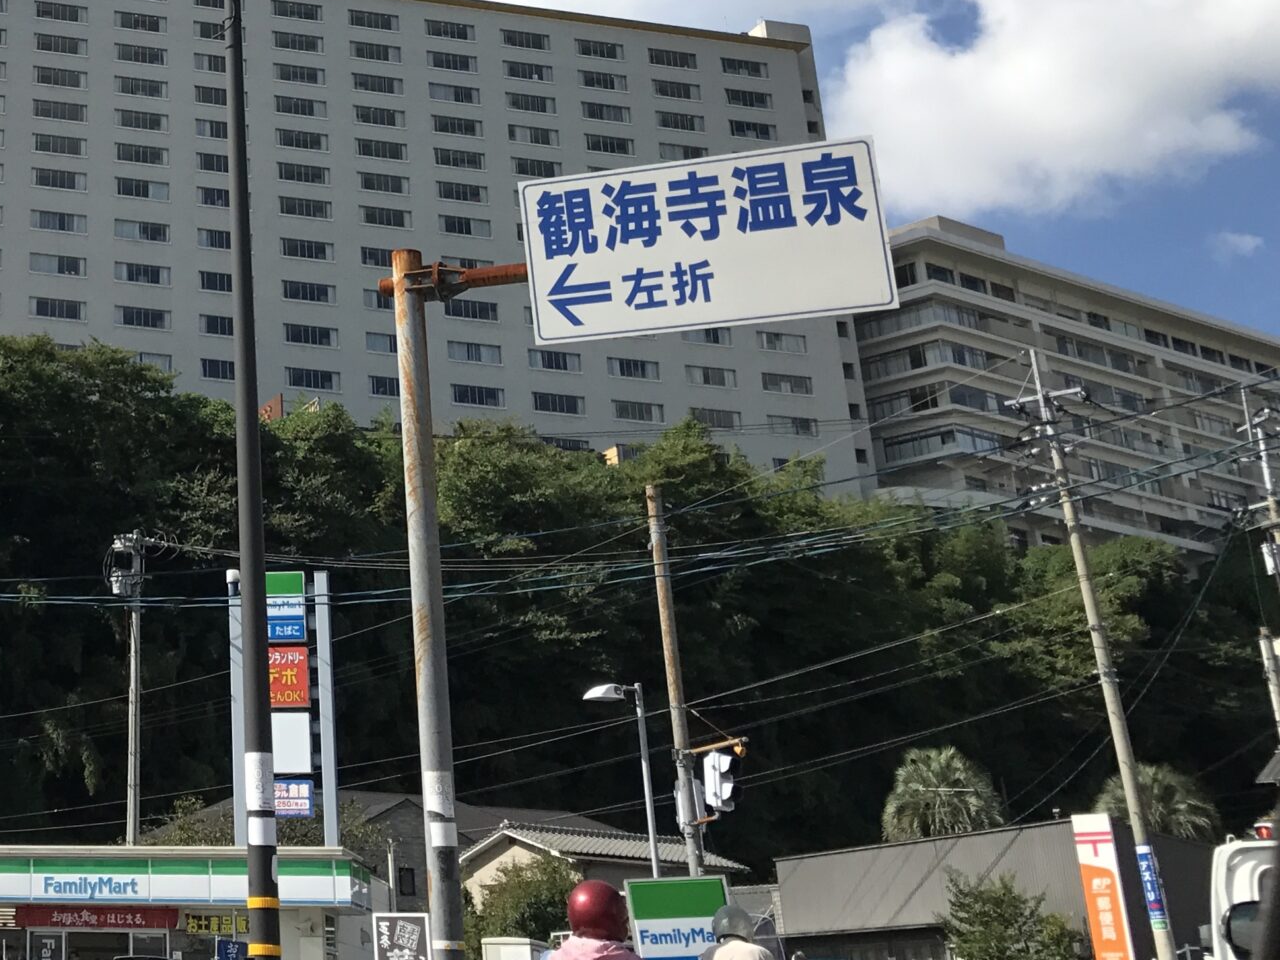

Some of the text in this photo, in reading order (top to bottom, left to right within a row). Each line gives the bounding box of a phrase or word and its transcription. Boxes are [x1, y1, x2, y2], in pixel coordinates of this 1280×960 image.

[535, 151, 869, 261] 観海寺温泉
[622, 258, 715, 312] 左折
[275, 625, 301, 636] たばこ
[268, 651, 305, 665] ンランドリー
[43, 876, 138, 899] FamilyMart
[186, 914, 249, 934] お土産品販
[639, 927, 716, 948] FamilyMa
